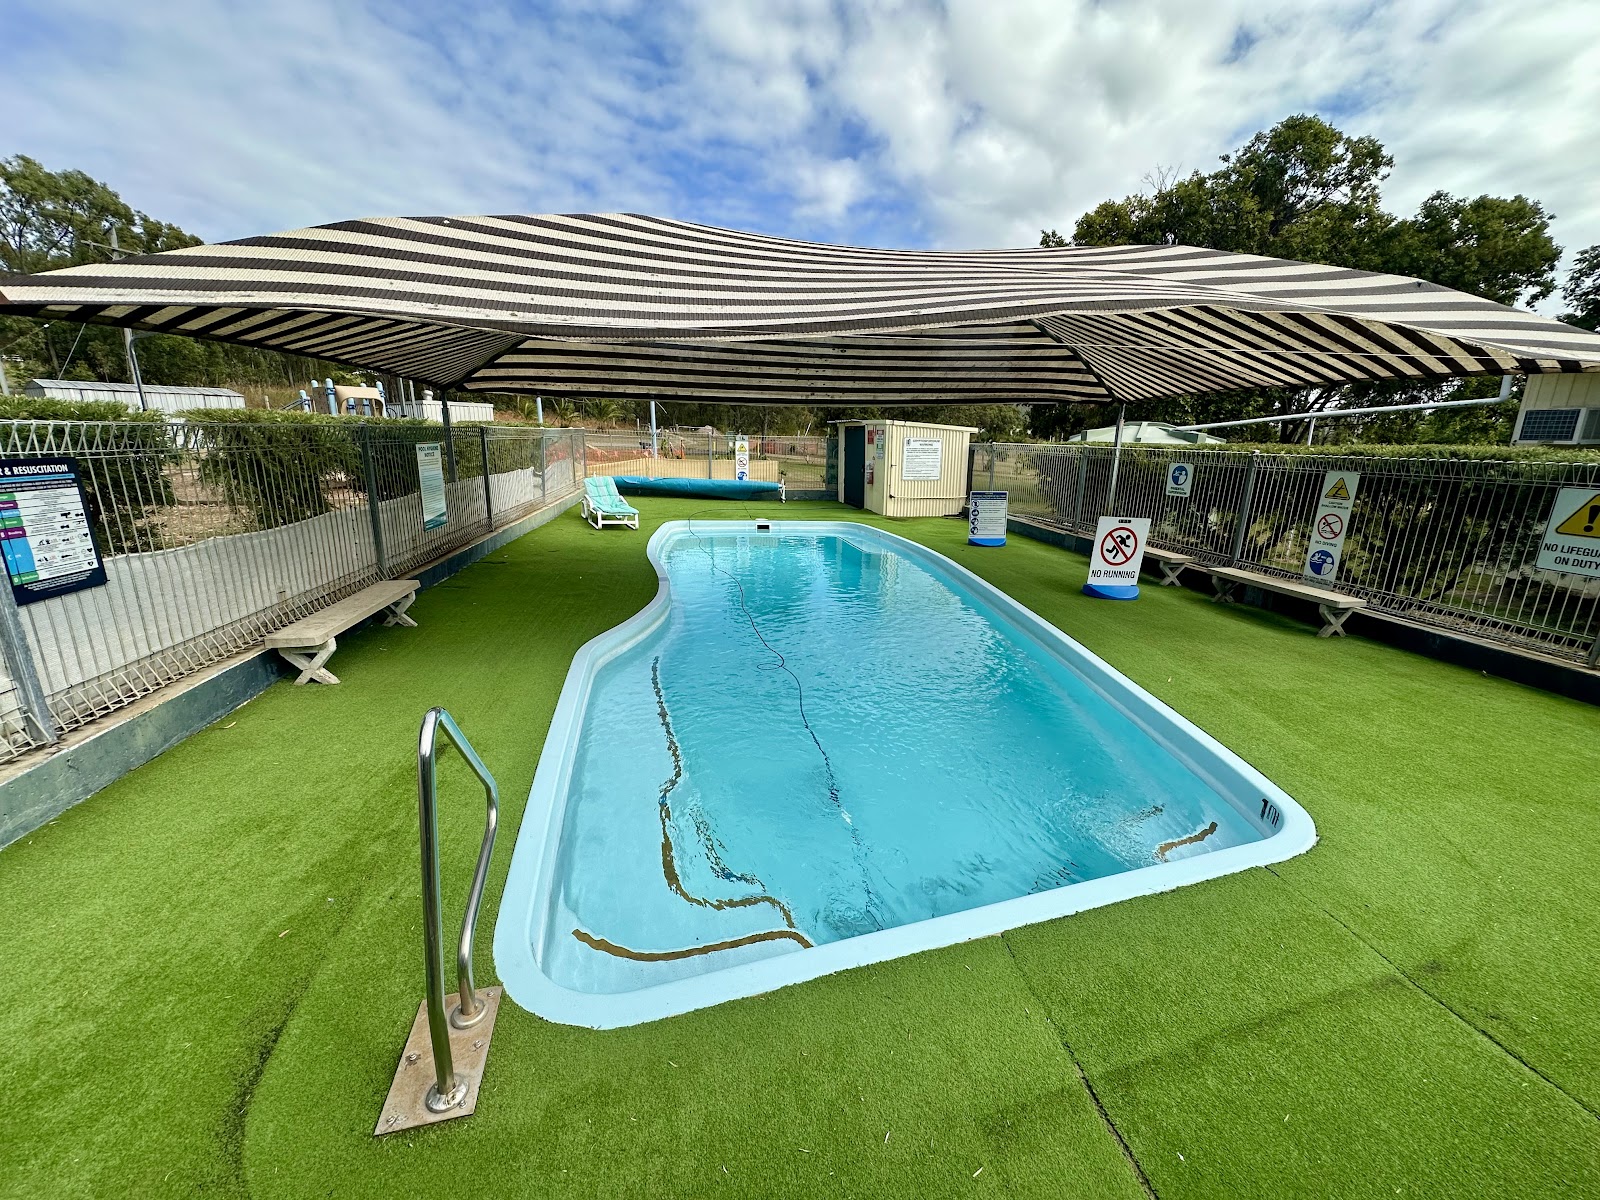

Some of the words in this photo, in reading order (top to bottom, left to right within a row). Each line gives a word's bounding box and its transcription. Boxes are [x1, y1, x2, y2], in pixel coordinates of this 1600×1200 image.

[4, 467, 12, 475] &
[12, 464, 69, 475] RESUSCITATION
[1543, 543, 1558, 552] NO
[1554, 556, 1570, 565] ON
[1572, 558, 1600, 570] DUTY
[1090, 569, 1102, 578] NO
[1103, 570, 1136, 578] RUNNING
